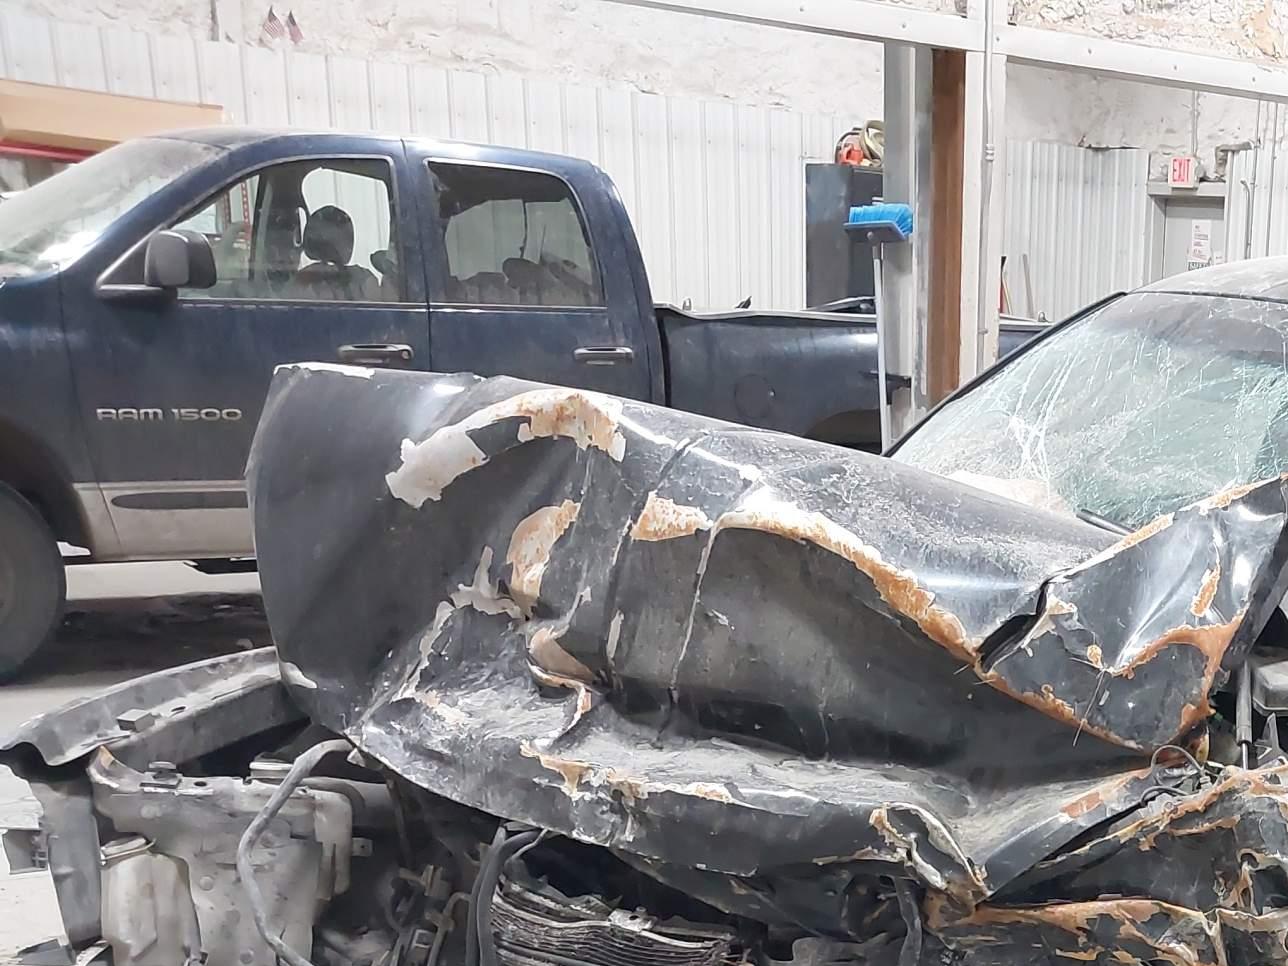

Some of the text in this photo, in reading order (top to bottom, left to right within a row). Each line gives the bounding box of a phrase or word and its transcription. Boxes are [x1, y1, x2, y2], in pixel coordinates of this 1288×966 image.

[1173, 159, 1191, 183] EXIT
[96, 408, 243, 421] RAM 1500
